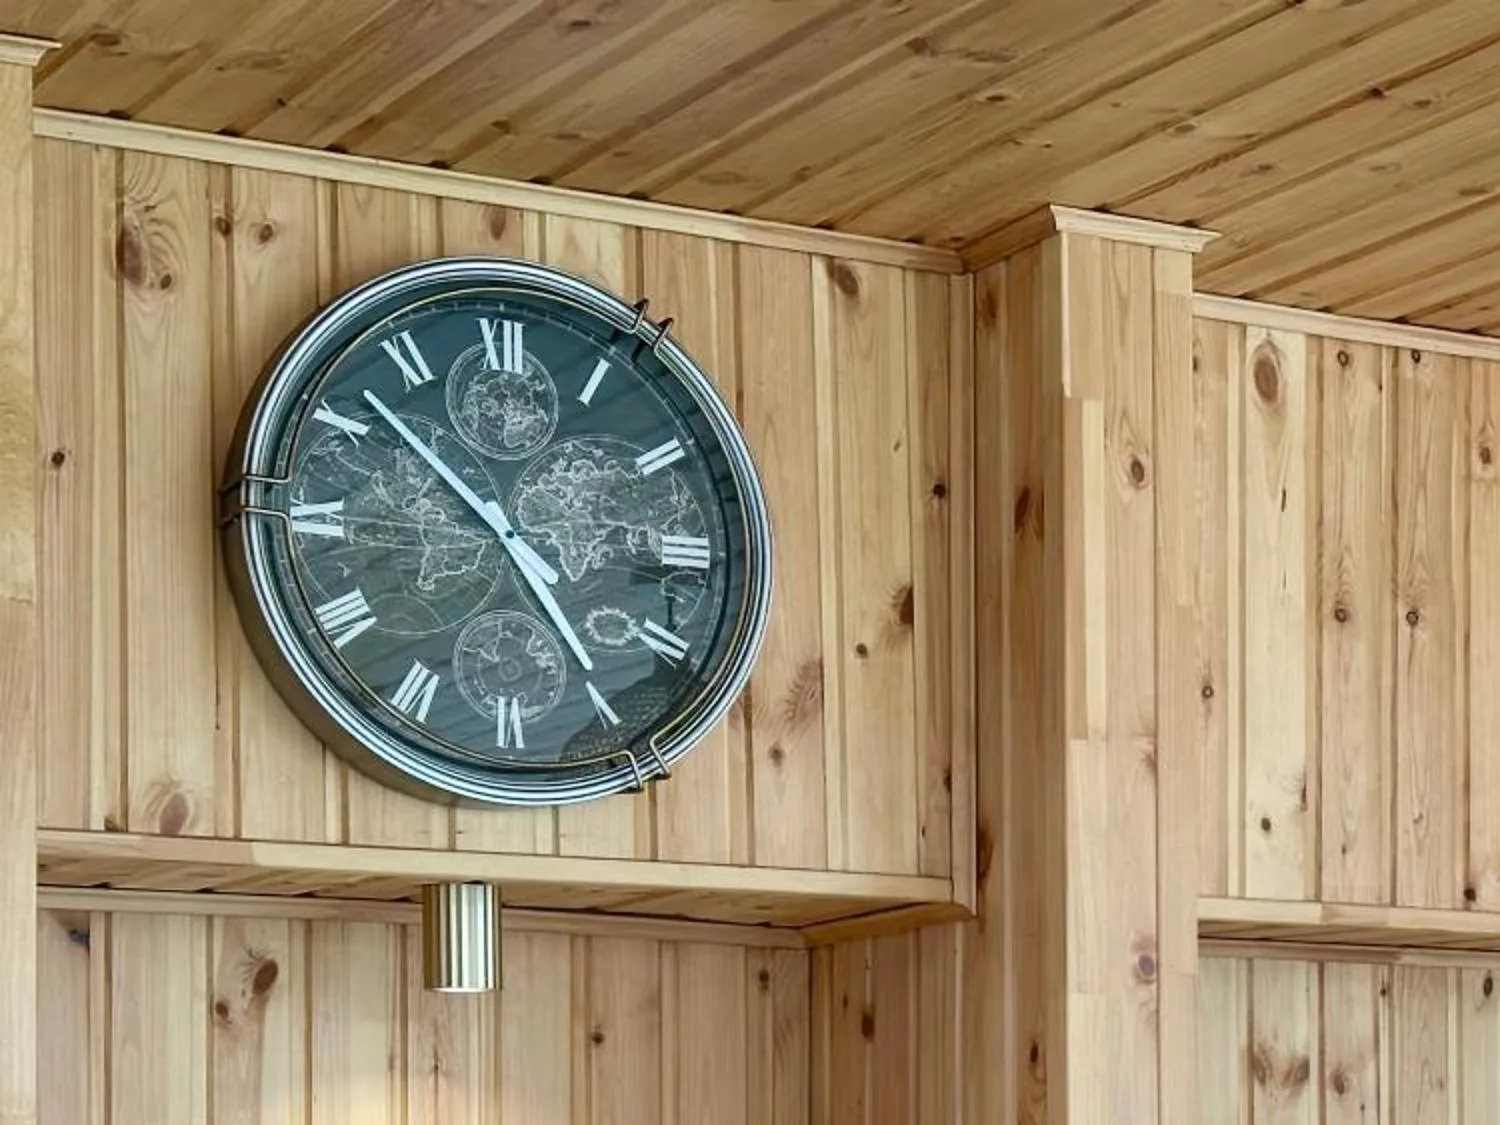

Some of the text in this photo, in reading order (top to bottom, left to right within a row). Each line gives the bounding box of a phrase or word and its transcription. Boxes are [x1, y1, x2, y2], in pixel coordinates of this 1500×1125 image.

[379, 330, 436, 391] XI
[476, 317, 525, 374] XII
[312, 400, 371, 447] X
[635, 437, 685, 476] II
[290, 499, 345, 537] IX
[661, 535, 710, 568] III
[314, 586, 377, 649] VIII
[390, 658, 439, 724] VII
